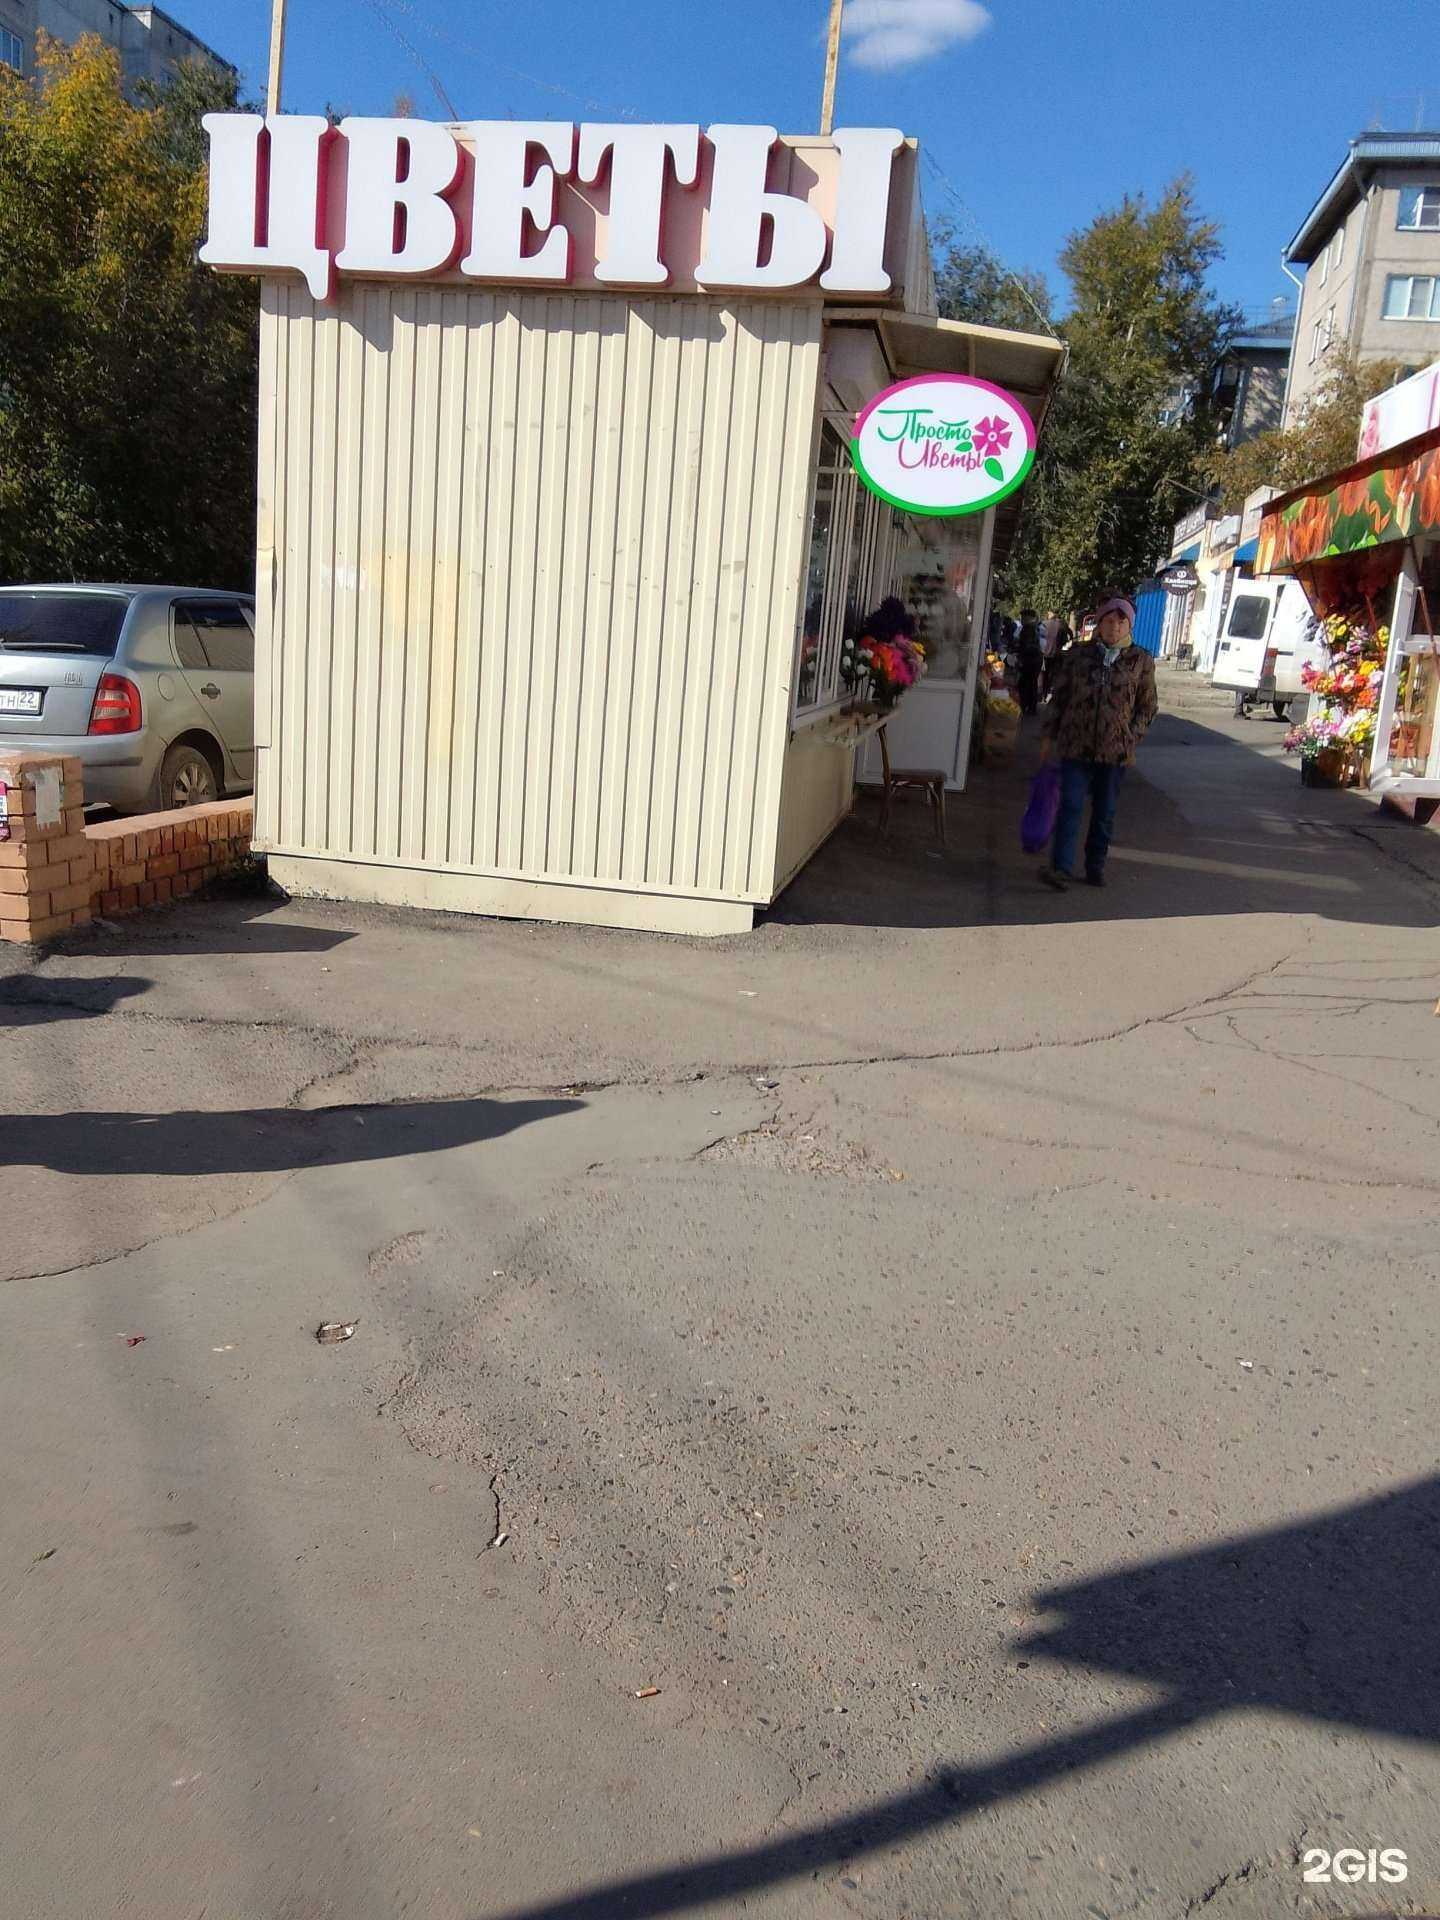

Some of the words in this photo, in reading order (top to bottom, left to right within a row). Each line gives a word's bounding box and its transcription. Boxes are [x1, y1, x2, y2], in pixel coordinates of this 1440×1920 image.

[199, 112, 905, 302] ЦВЕТЫ
[877, 408, 972, 444] Просто
[897, 437, 985, 473] Цветы
